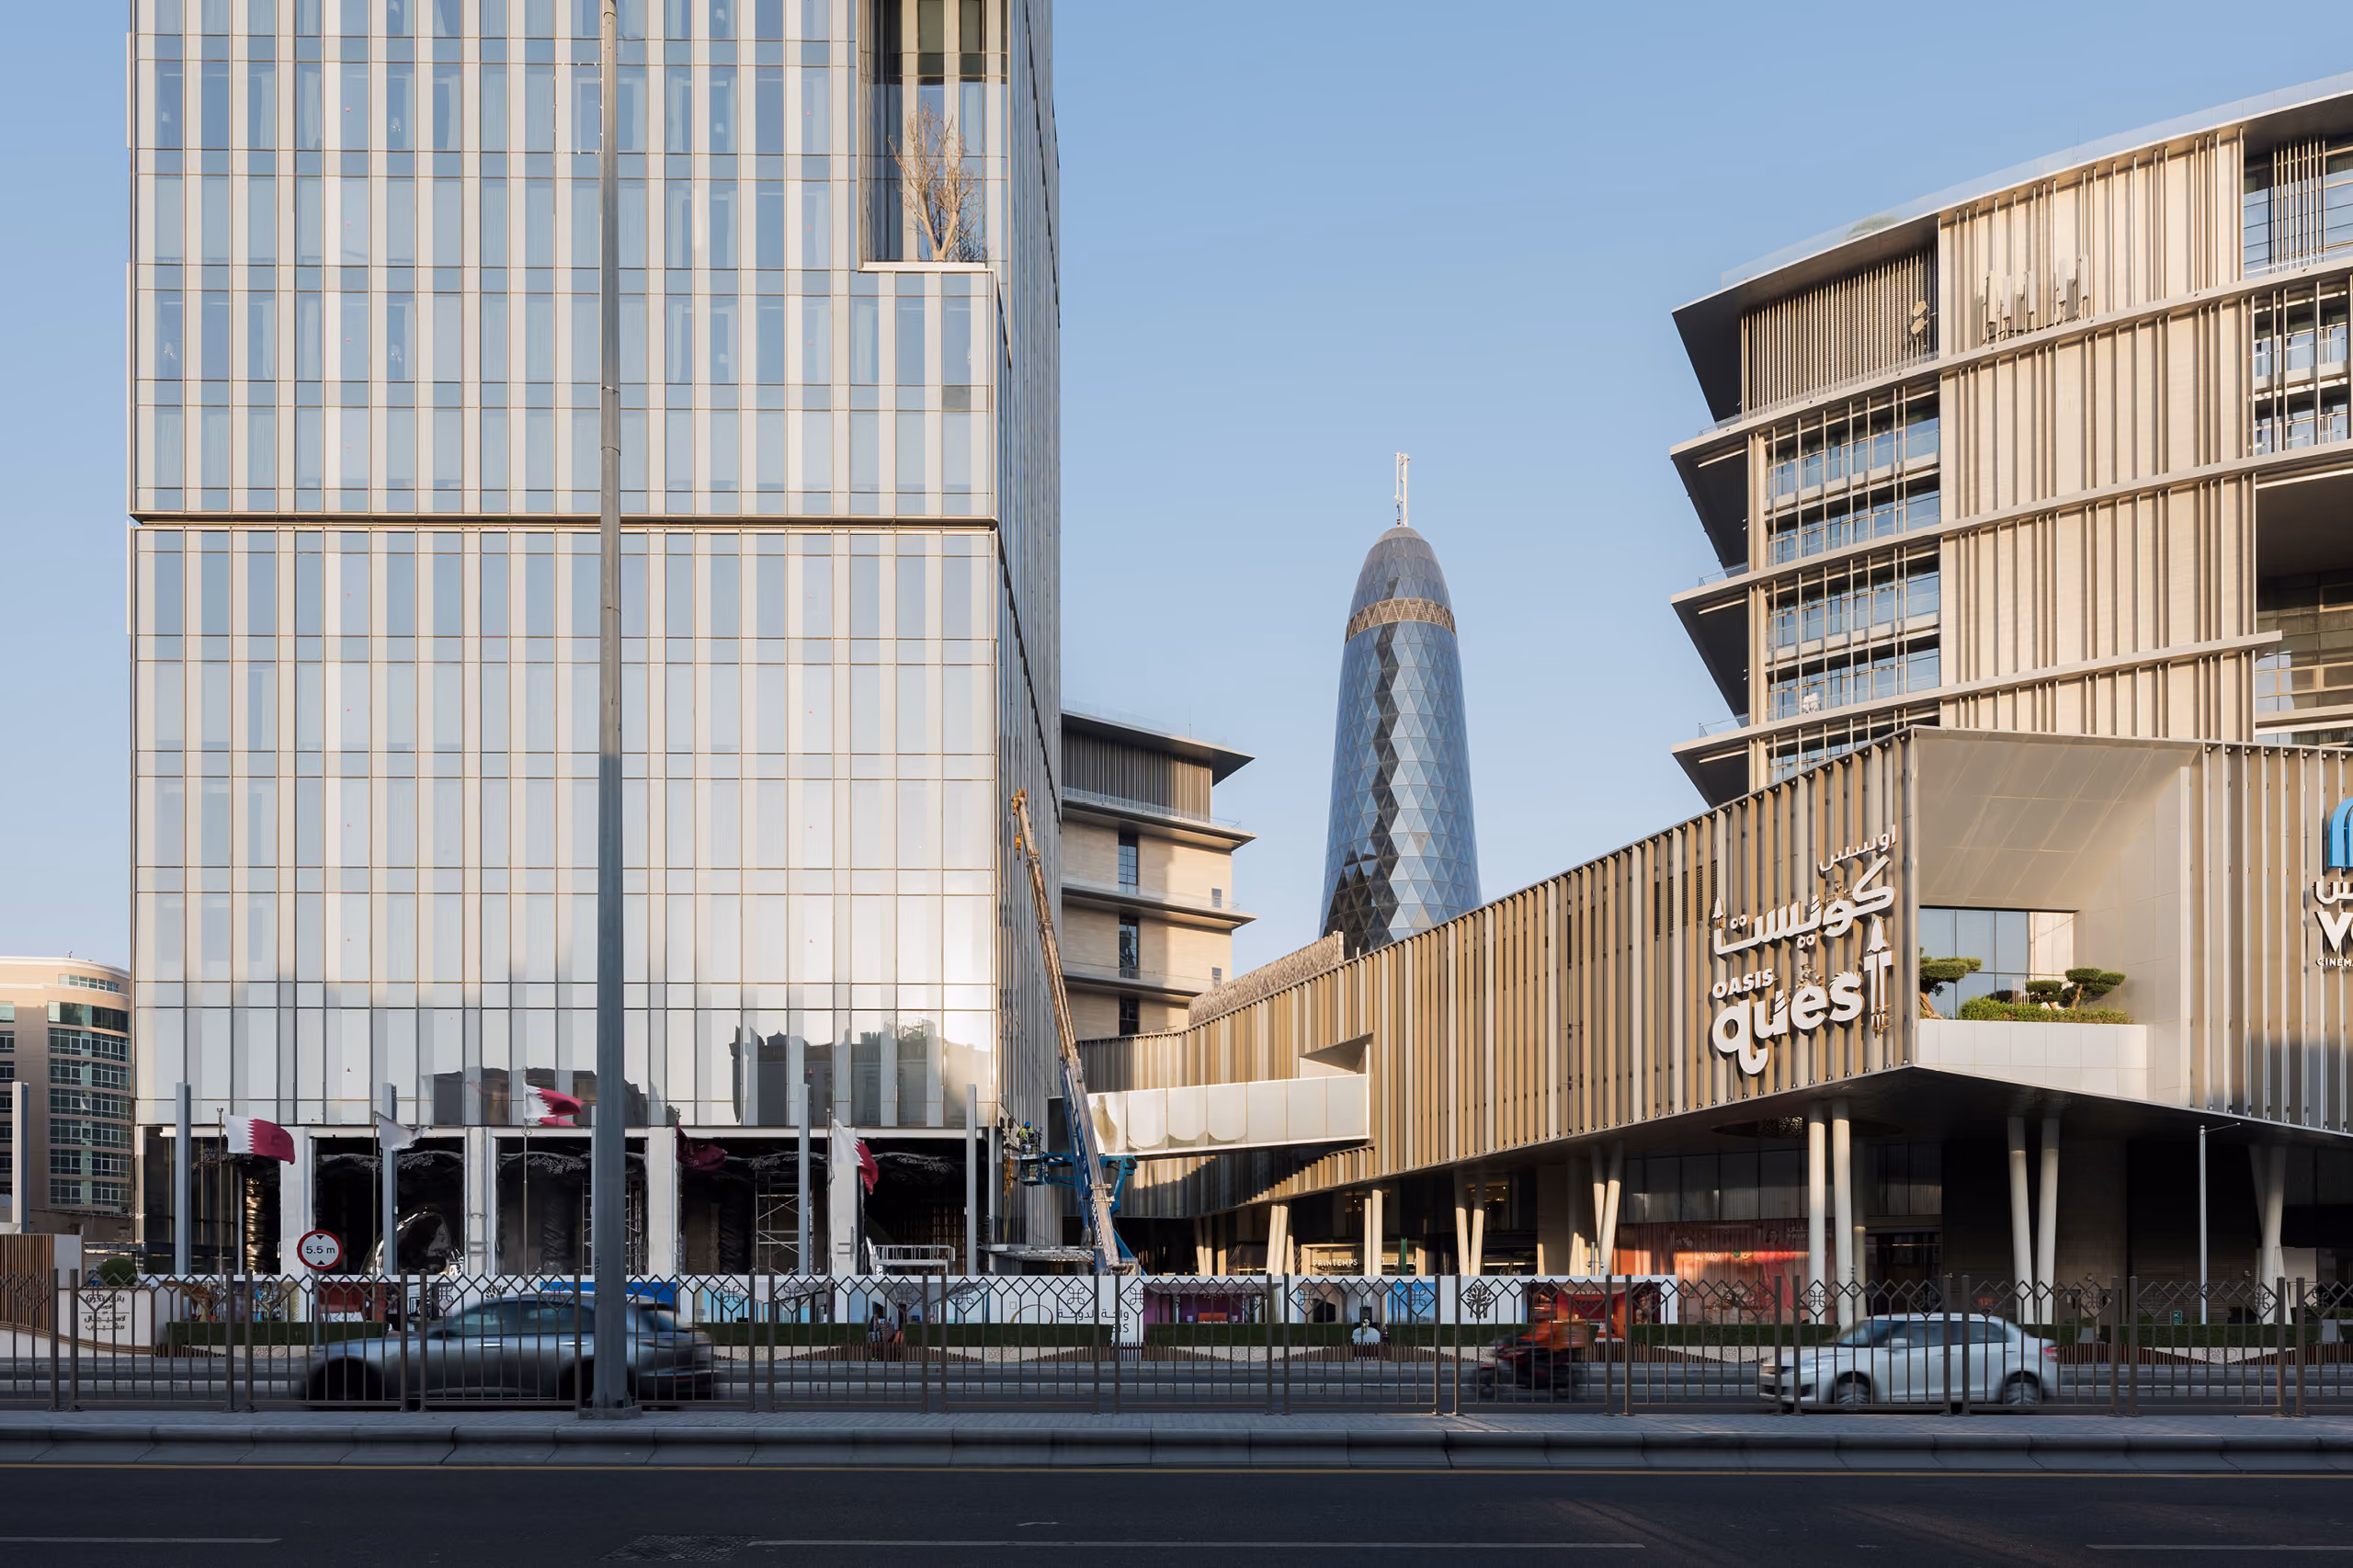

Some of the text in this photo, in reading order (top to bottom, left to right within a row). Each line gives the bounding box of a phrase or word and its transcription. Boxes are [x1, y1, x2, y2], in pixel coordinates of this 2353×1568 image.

[2316, 958, 2353, 967] CINEM
[1712, 968, 1774, 999] OASIS
[306, 1245, 324, 1254] 5.5
[1313, 1258, 1358, 1267] PRINTEMPS
